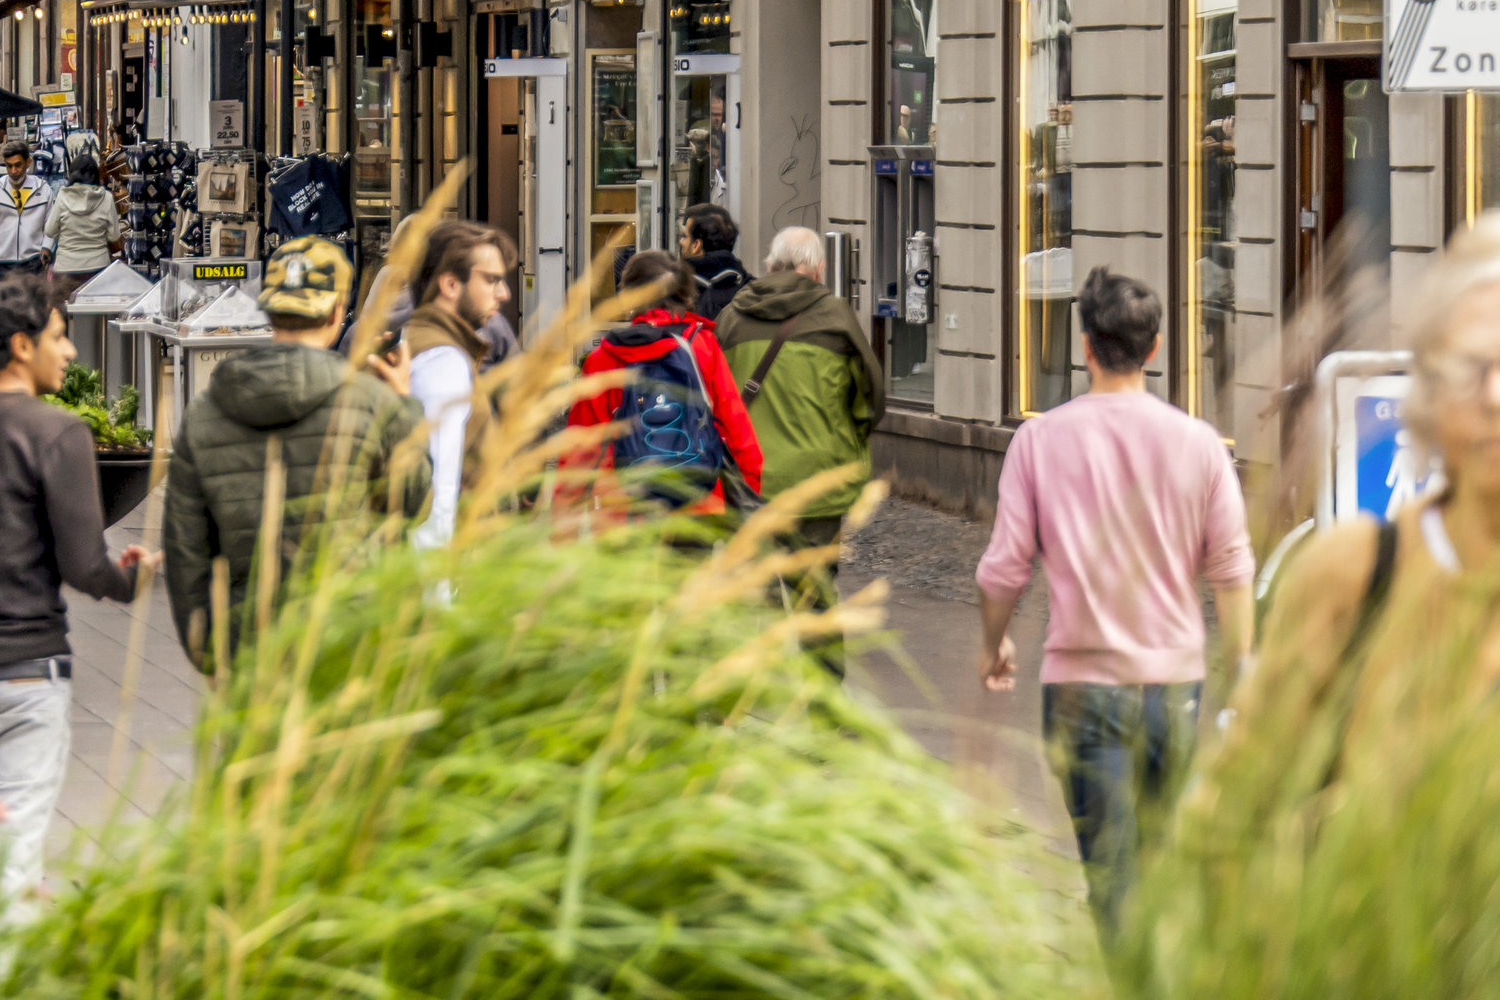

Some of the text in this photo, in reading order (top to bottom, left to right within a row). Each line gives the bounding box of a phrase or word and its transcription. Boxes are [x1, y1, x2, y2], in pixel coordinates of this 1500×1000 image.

[224, 115, 232, 126] 3
[301, 120, 311, 130] 10
[301, 136, 311, 147] 75
[195, 266, 245, 278] UDSALG
